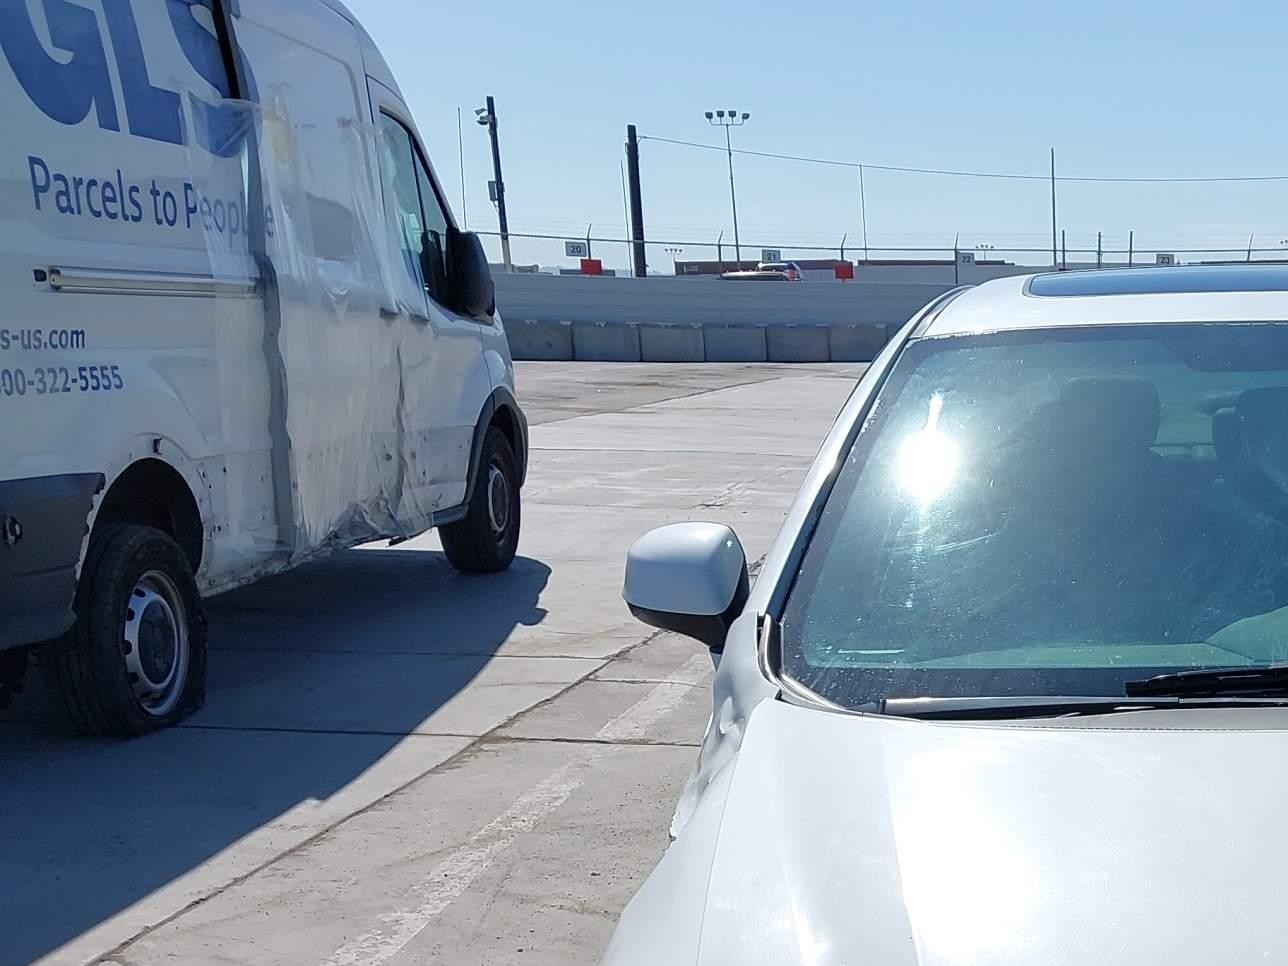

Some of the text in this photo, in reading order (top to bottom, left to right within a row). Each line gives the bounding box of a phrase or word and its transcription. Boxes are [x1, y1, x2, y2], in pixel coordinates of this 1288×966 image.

[28, 156, 143, 222] Parcels
[150, 179, 177, 227] to
[570, 245, 582, 254] 20
[767, 253, 776, 261] 21
[1160, 256, 1170, 264] 23
